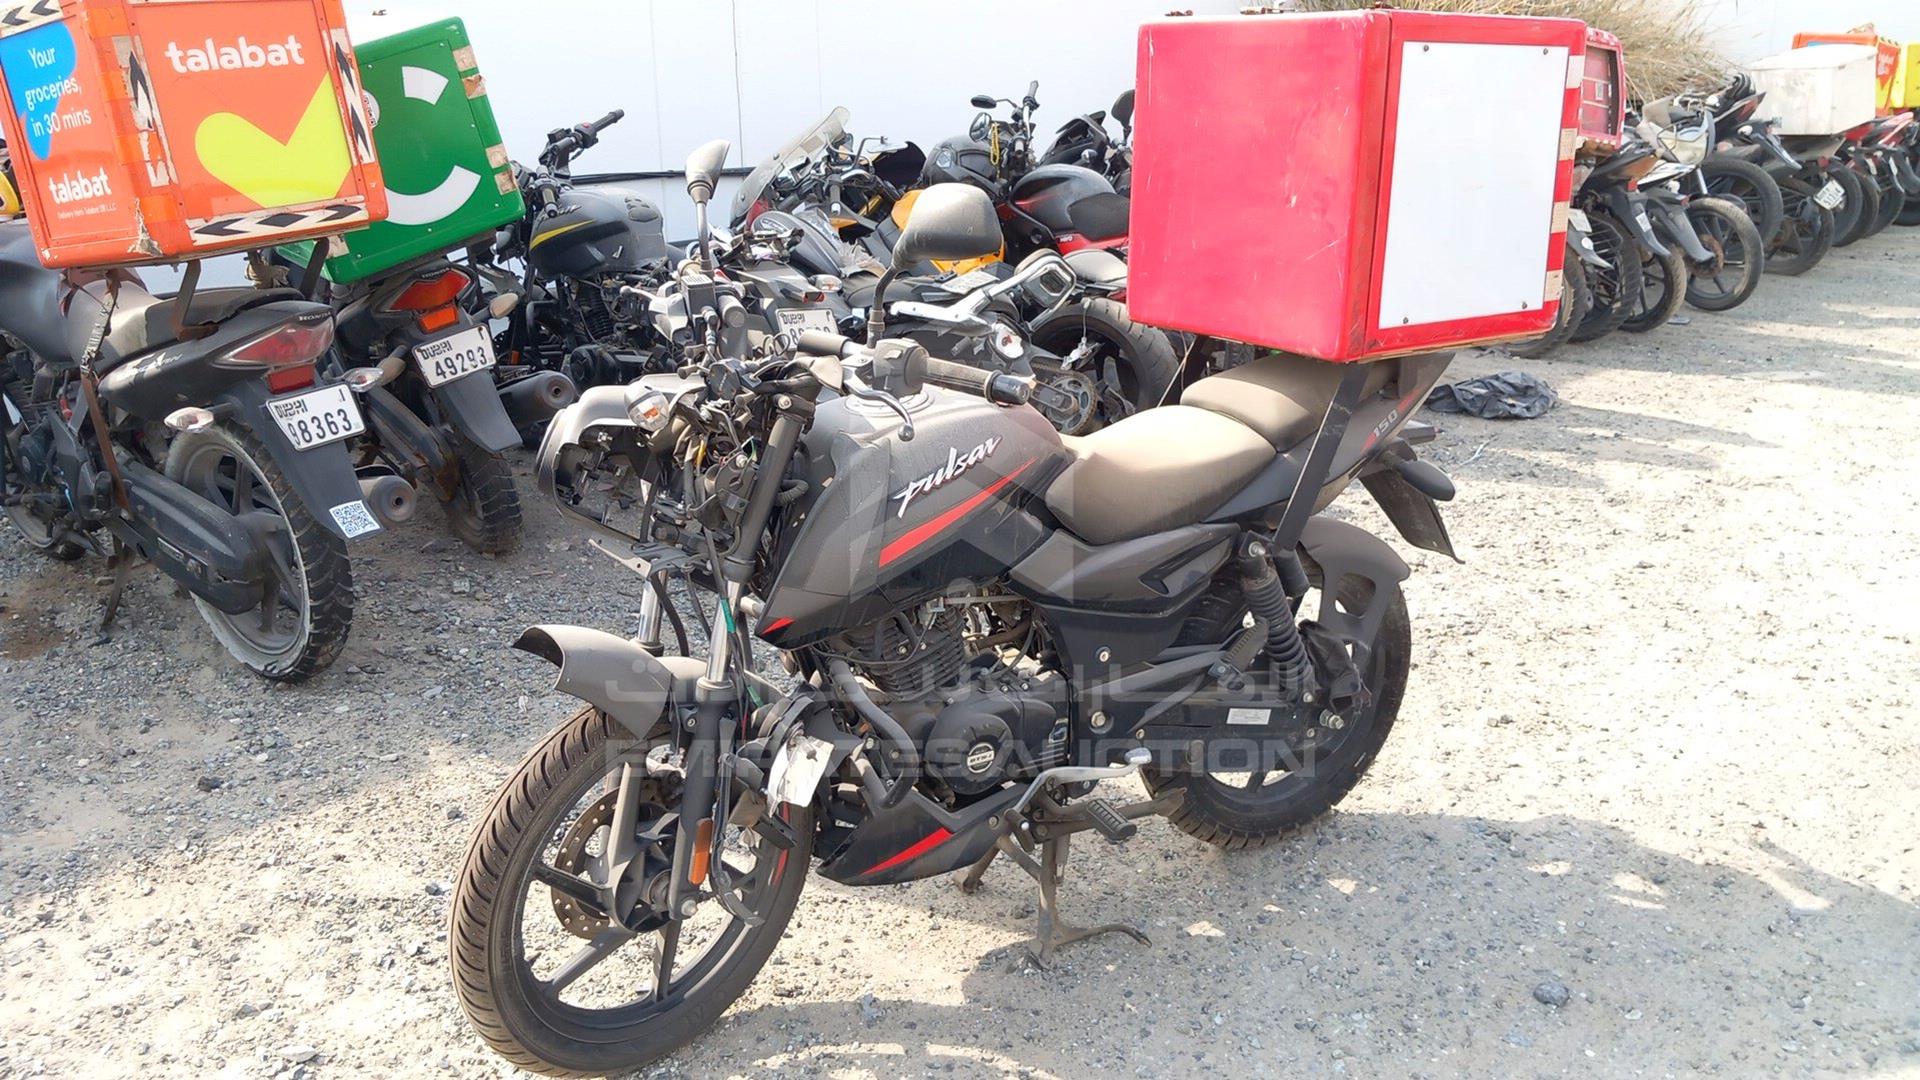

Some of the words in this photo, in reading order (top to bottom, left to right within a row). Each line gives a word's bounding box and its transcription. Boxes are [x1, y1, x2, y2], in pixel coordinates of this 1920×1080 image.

[28, 46, 56, 69] Your
[164, 34, 304, 74] talabat
[25, 75, 82, 111] groceries,
[31, 117, 45, 138] in
[44, 112, 61, 134] 30
[62, 107, 92, 130] mins
[48, 166, 112, 205] talabat
[435, 346, 488, 379] 49293
[287, 408, 353, 446] 98363
[1374, 409, 1398, 437] 150
